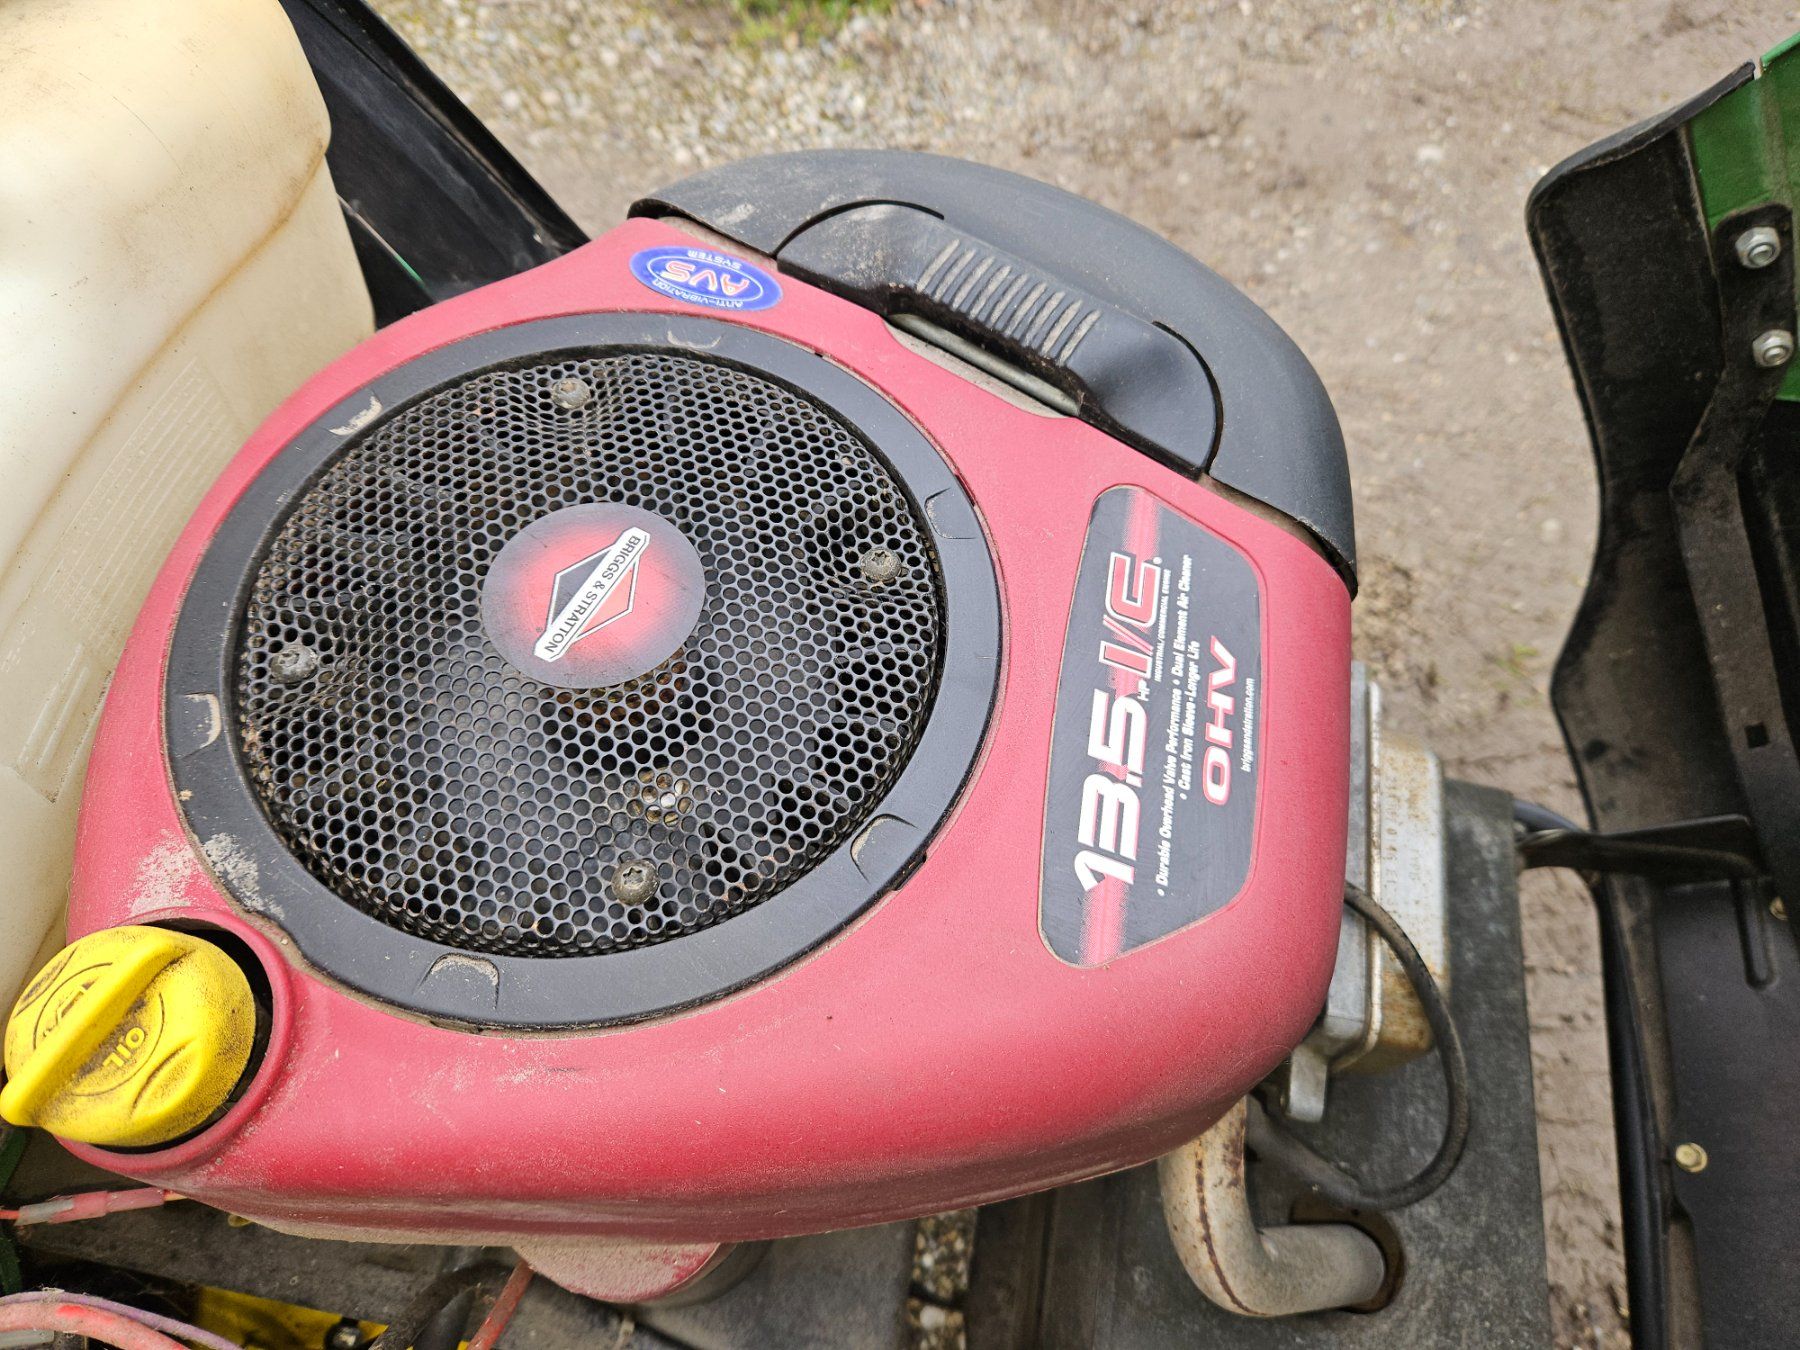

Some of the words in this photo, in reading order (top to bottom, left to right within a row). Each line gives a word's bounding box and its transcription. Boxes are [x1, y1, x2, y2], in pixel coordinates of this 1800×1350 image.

[660, 260, 750, 296] AVS
[687, 250, 742, 270] SYSTEM
[602, 535, 641, 580] BRIGGS
[1178, 554, 1192, 592] Cleaner
[593, 580, 606, 590] &
[1162, 569, 1172, 594] ENGINE
[1177, 592, 1189, 609] Air
[544, 591, 598, 653] STRATTON
[1173, 611, 1188, 650] Element
[1171, 651, 1185, 677] Dual
[1187, 640, 1200, 660] Life
[1165, 688, 1182, 754] Performance
[1203, 635, 1236, 806] OHV
[1241, 677, 1255, 773] briggsandstratton.com
[1180, 737, 1194, 761] Iron
[1074, 688, 1148, 892] 13.5
[1137, 679, 1150, 701] HP
[1162, 756, 1177, 785] Valve
[1178, 761, 1192, 791] Cast
[1159, 785, 1175, 839] Overhead
[1155, 841, 1171, 887] Durable
[102, 1026, 146, 1068] OIL
